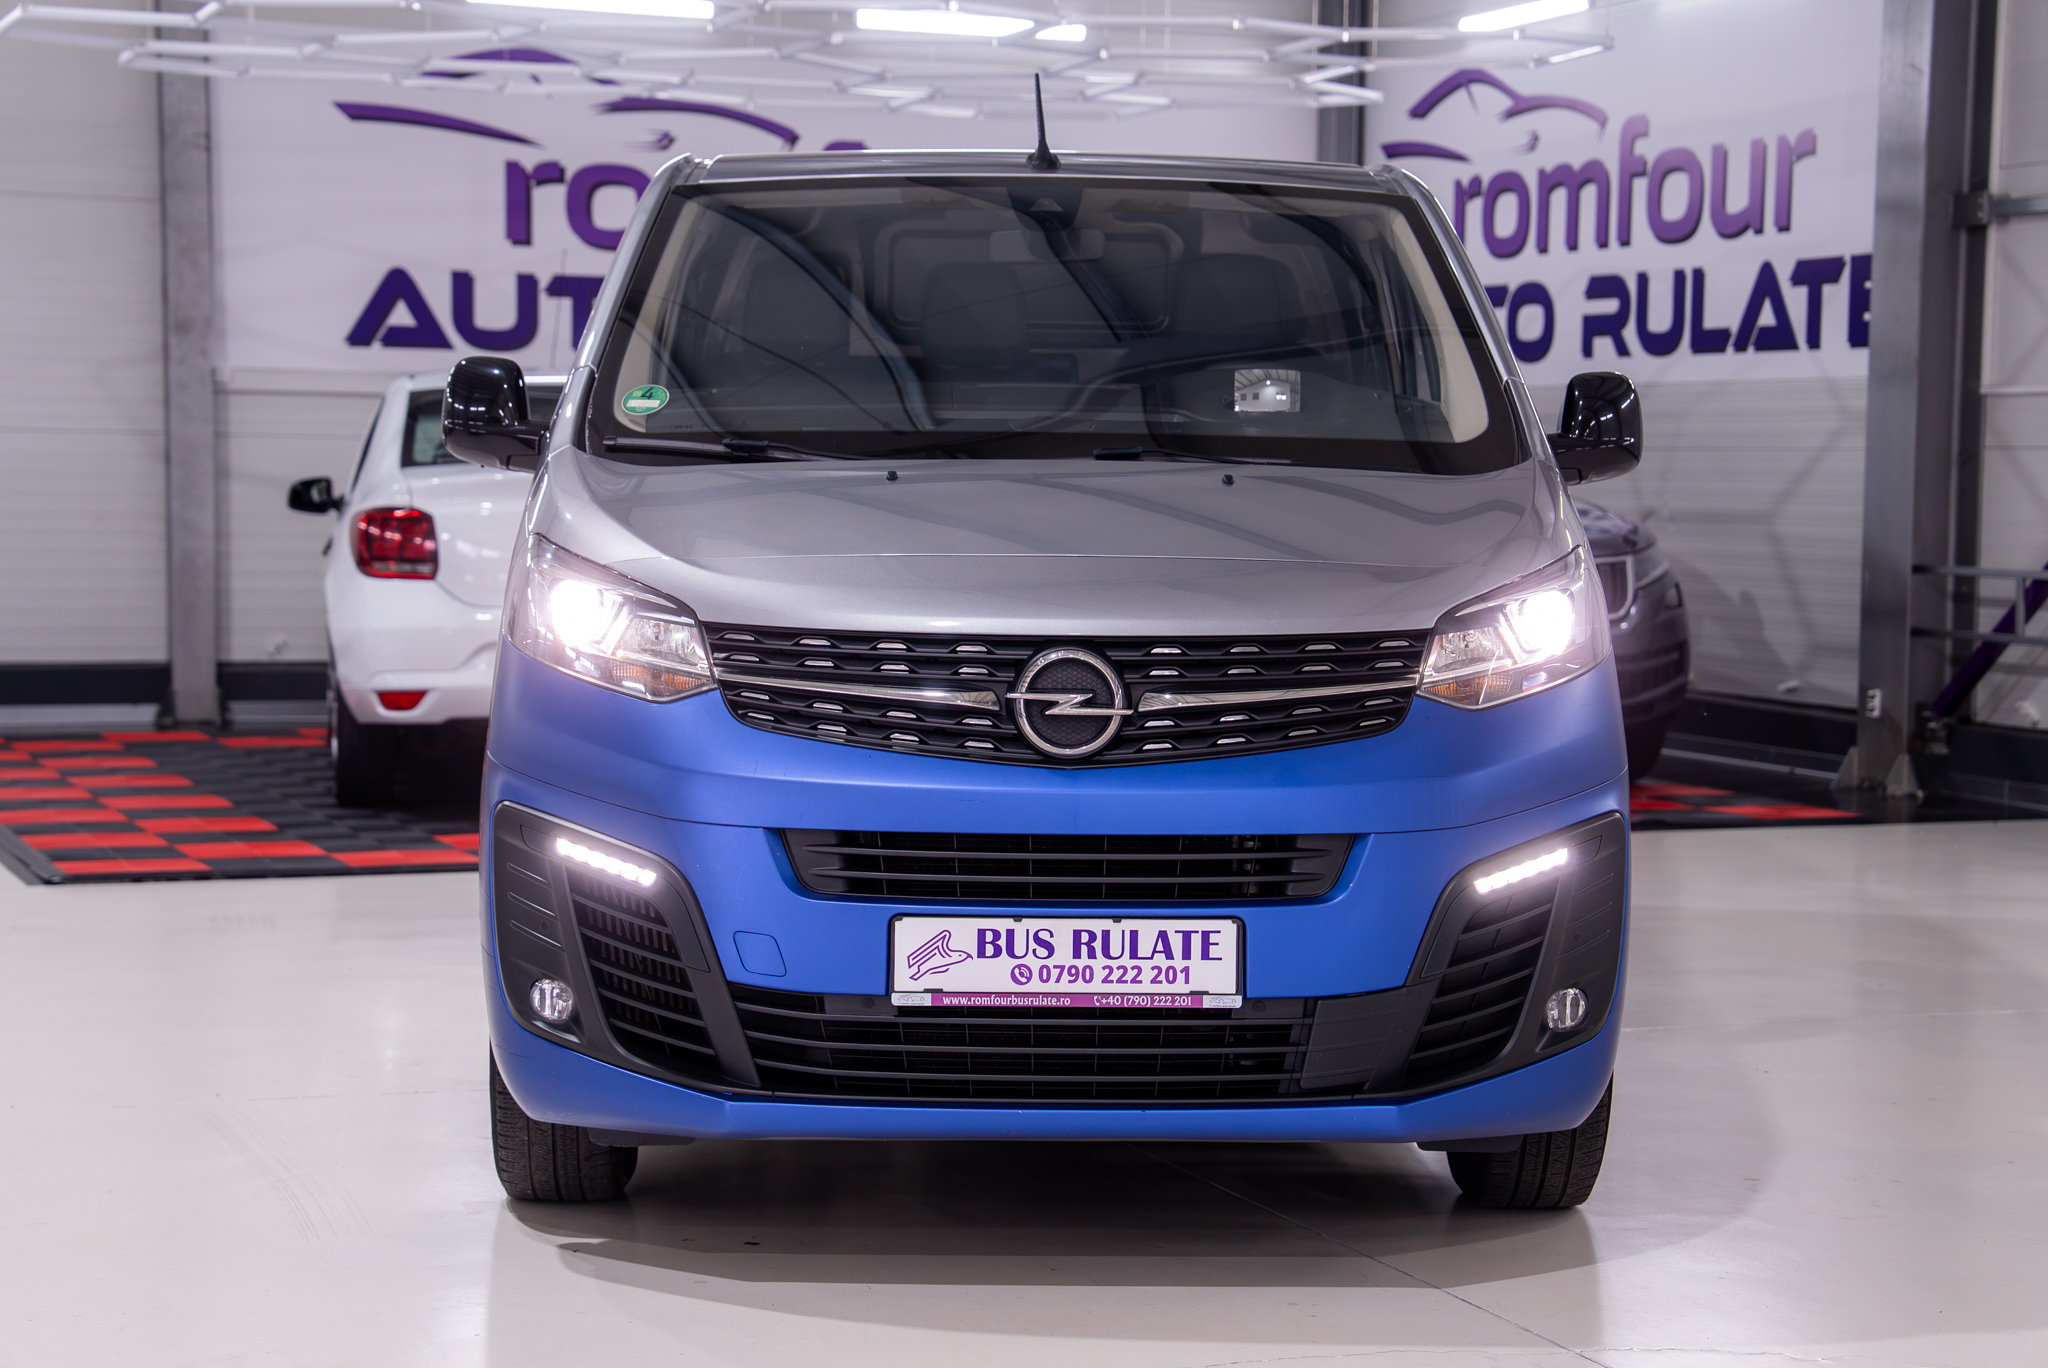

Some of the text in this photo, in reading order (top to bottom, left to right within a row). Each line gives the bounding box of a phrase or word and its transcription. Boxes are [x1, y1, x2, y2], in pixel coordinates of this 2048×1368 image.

[1453, 113, 1816, 259] romfour
[976, 928, 1223, 961] BUS RULATE
[1038, 964, 1190, 985] 0790 222 201
[942, 994, 1071, 1006] www.romfourbusrulate.ro
[1101, 995, 1192, 1007] +40 (790) 222 201
